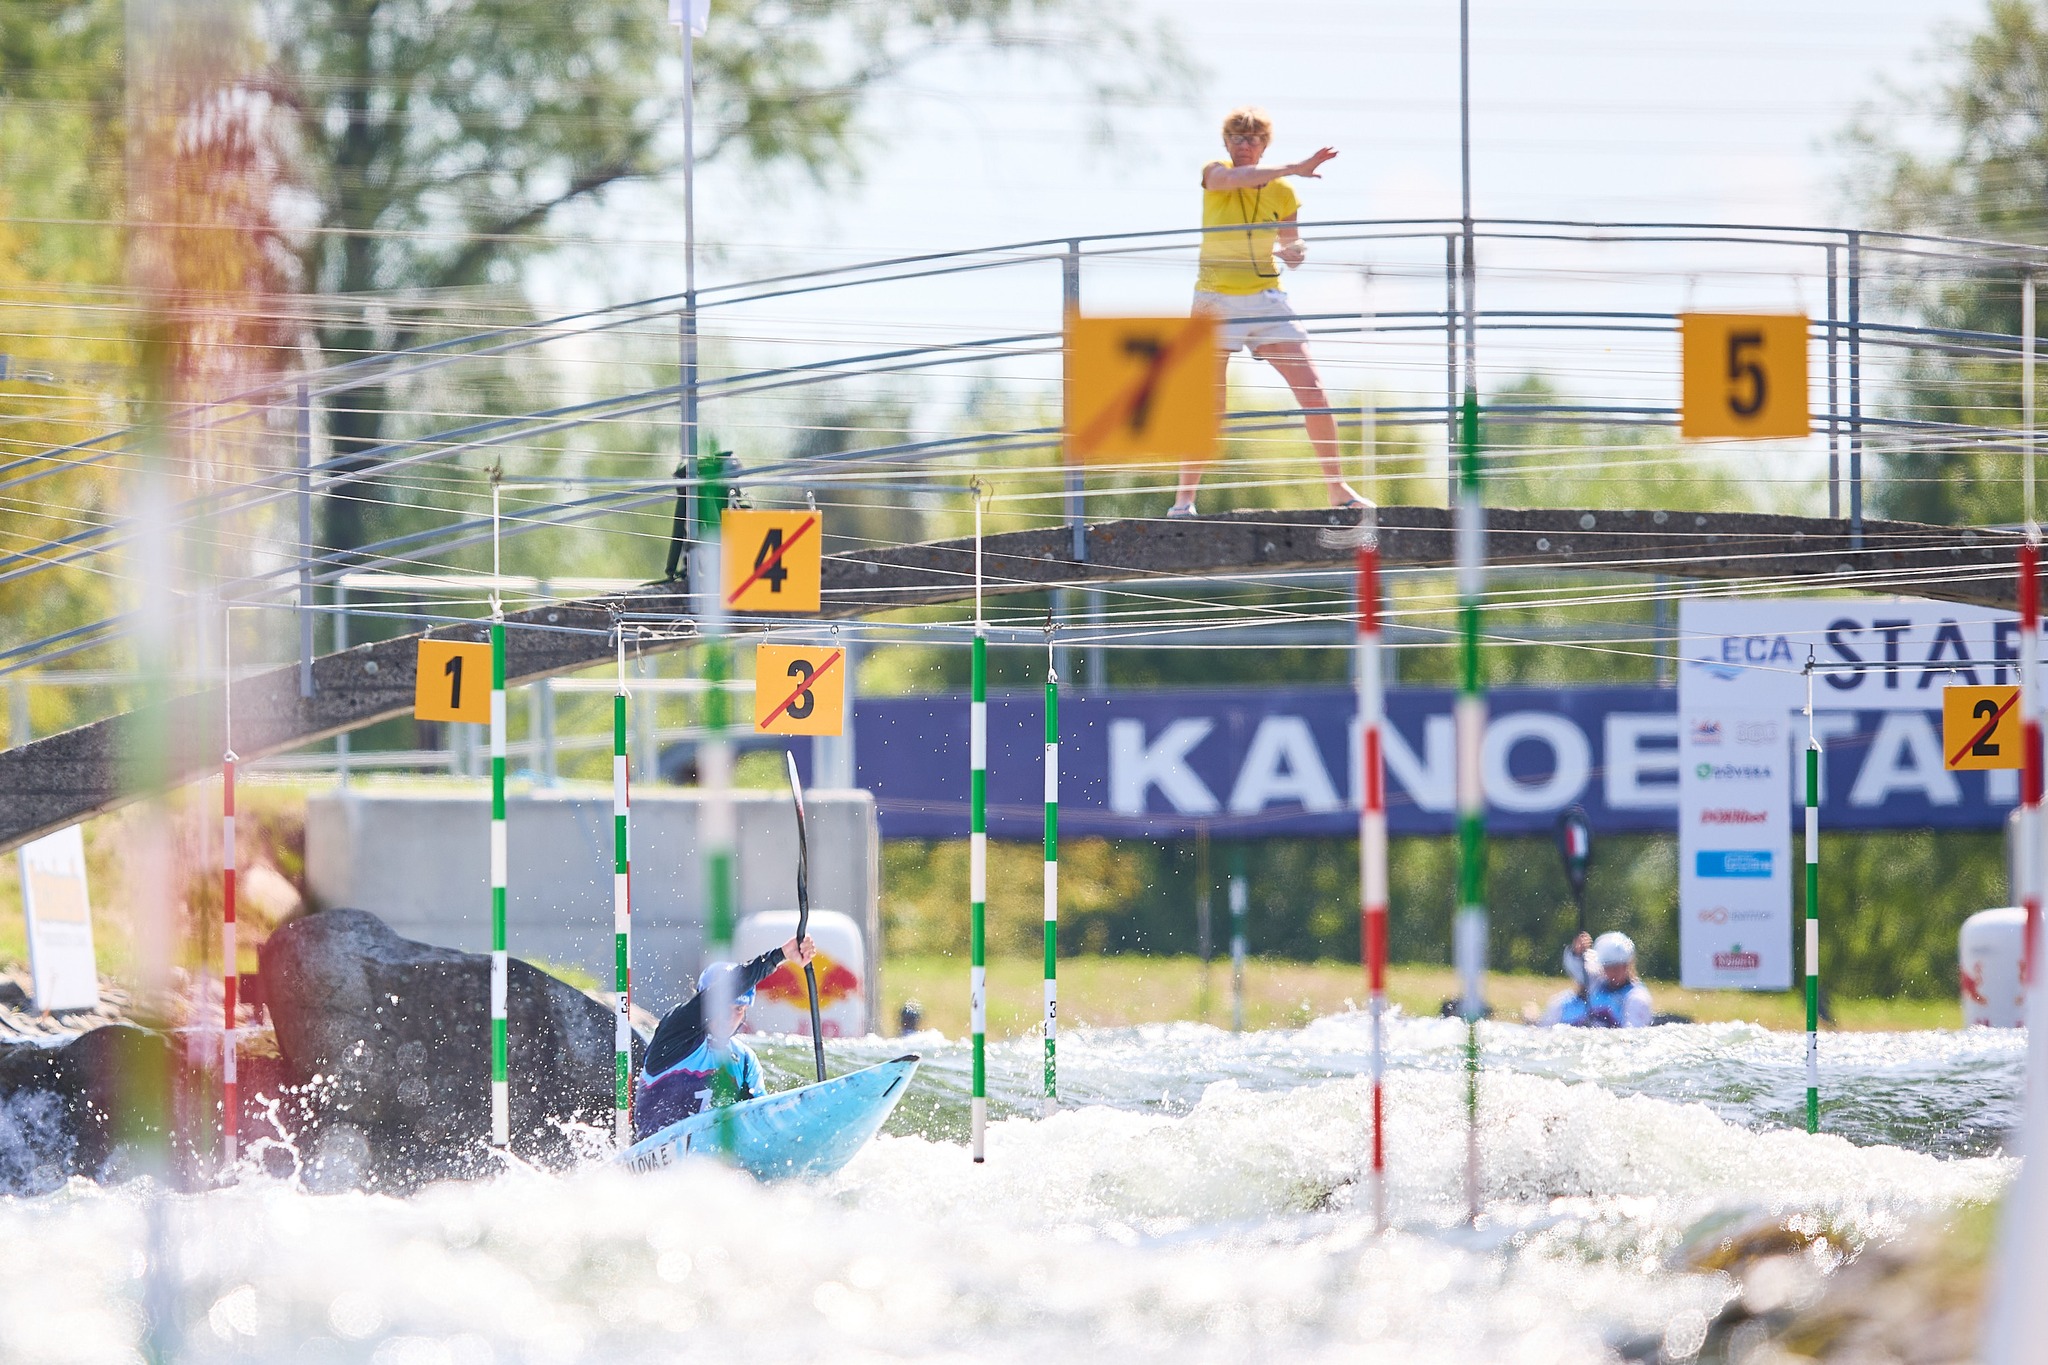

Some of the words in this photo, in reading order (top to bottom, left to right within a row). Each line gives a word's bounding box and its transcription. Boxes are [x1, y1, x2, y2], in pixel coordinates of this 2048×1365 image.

[1121, 336, 1167, 432] 7
[1727, 331, 1768, 419] 5
[754, 528, 787, 593] 4
[1722, 634, 1793, 665] ECA
[444, 655, 463, 709] 1
[786, 659, 815, 720] 3
[1972, 699, 2000, 757] 2
[1107, 712, 1682, 817] KANOE
